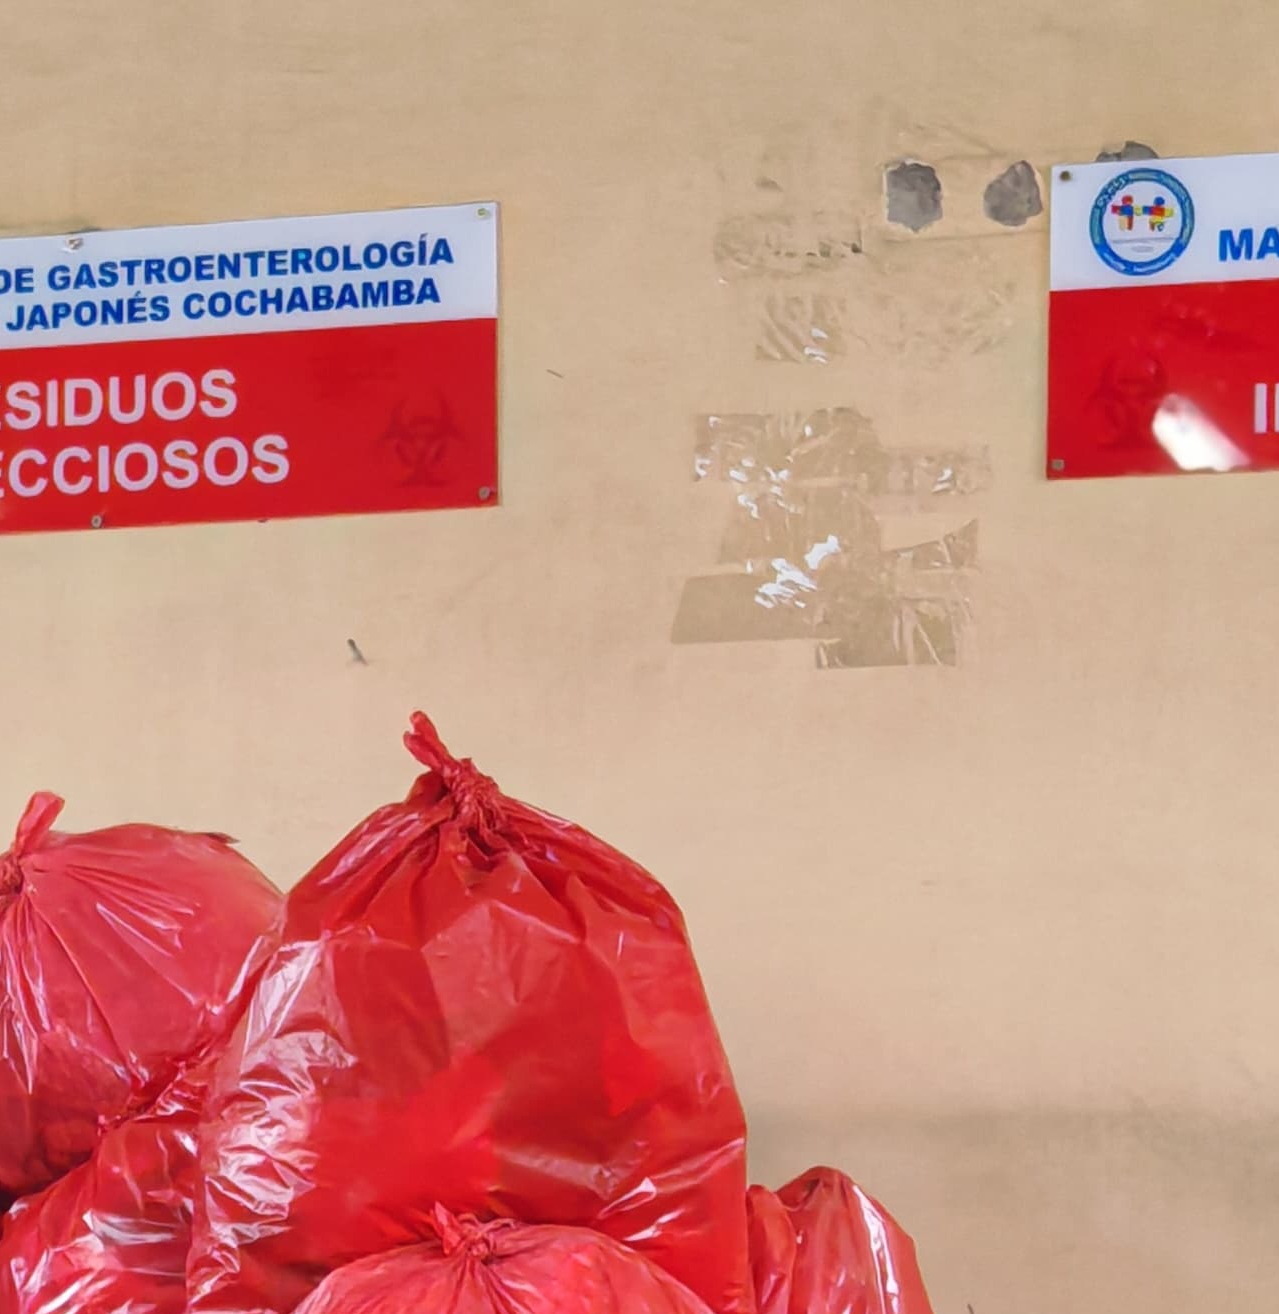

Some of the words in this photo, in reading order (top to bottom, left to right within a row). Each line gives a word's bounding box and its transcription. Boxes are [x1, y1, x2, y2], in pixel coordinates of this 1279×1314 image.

[47, 233, 454, 292] GASTROENTEROLOGÍA
[5, 289, 171, 332] JAPONÉS
[182, 277, 441, 320] COCHABAMBA
